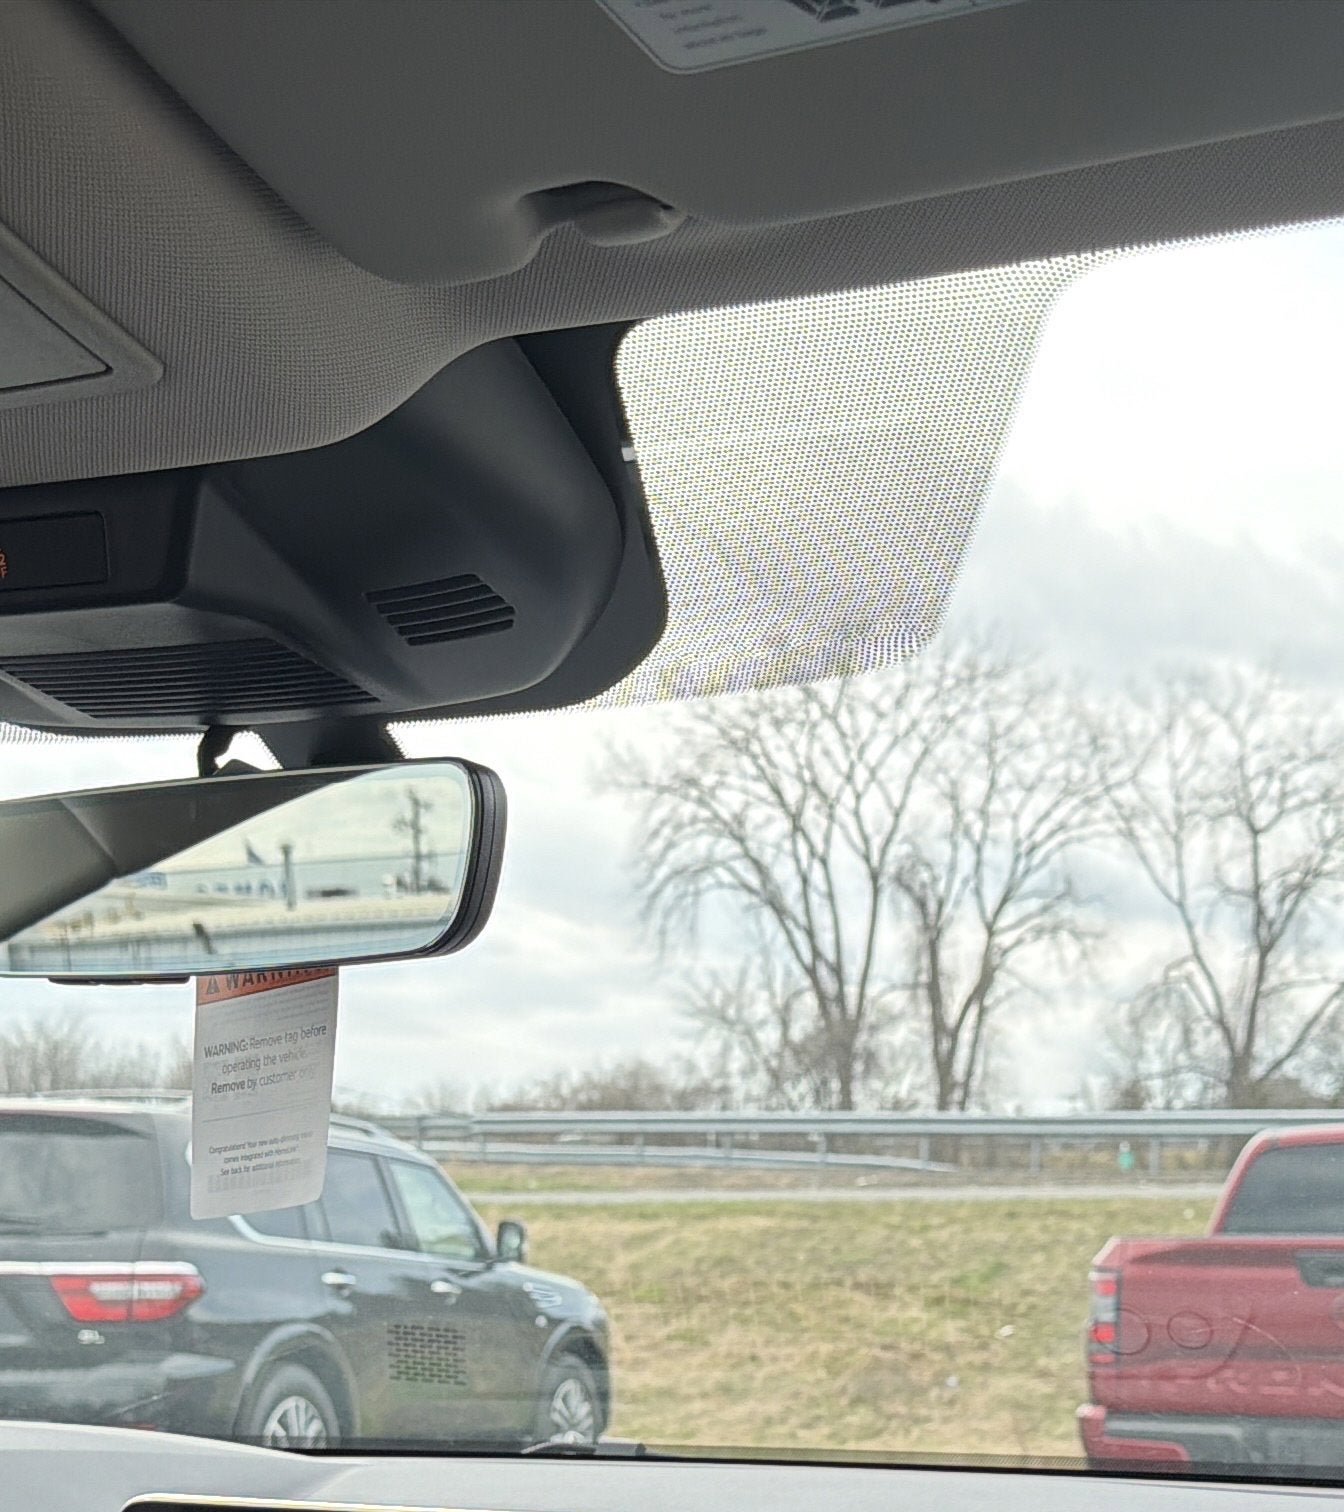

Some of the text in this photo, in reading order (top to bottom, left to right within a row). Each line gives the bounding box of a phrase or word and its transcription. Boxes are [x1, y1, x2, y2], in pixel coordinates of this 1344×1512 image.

[249, 1034, 282, 1049] Remove
[285, 1031, 298, 1044] tag
[301, 1025, 326, 1040] before
[263, 1054, 276, 1067] the
[212, 1080, 245, 1094] Remove
[247, 1076, 257, 1090] by
